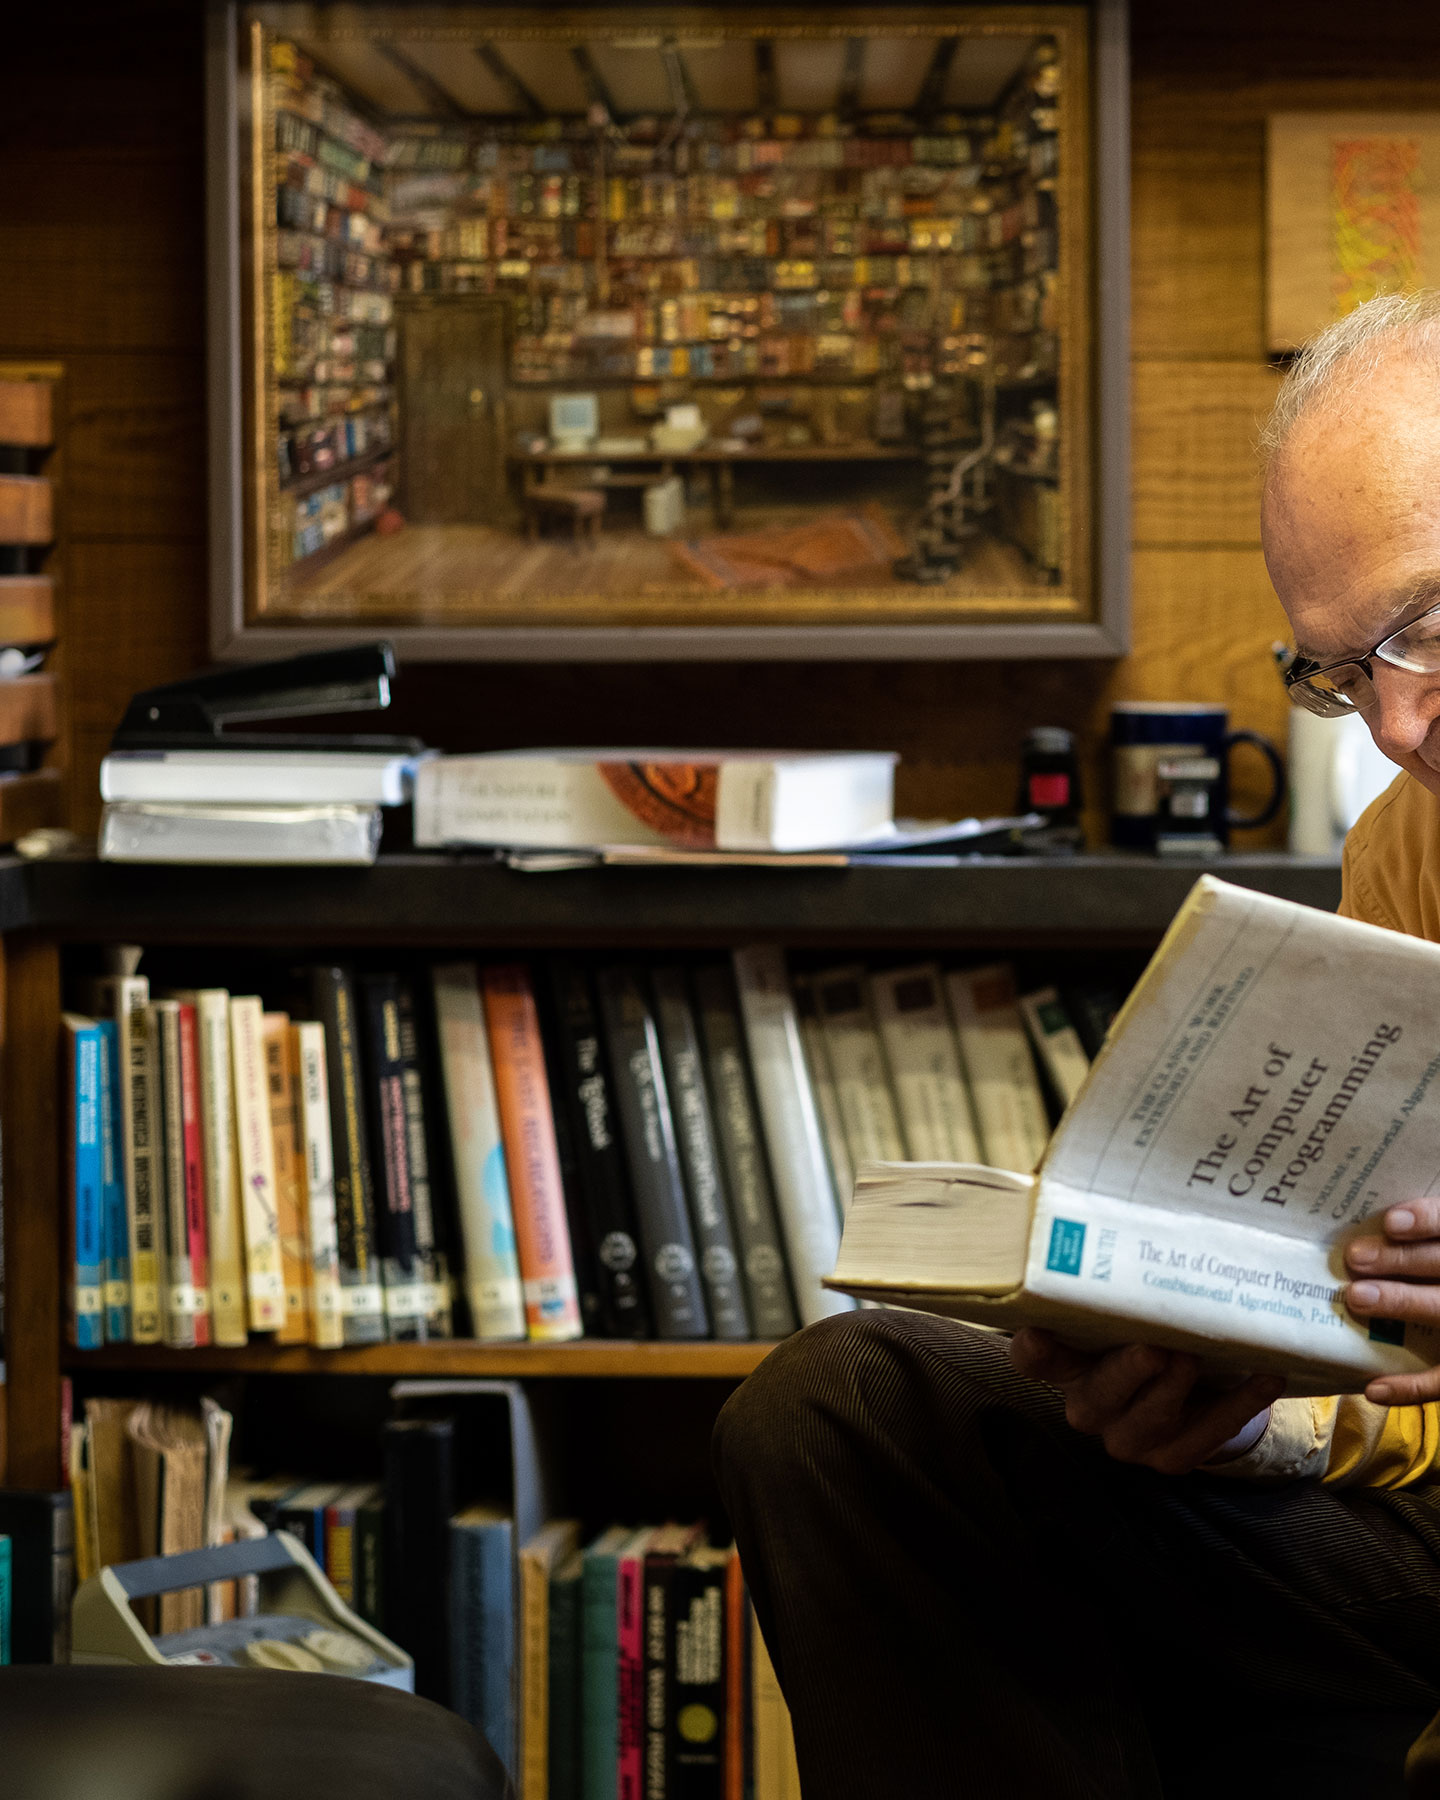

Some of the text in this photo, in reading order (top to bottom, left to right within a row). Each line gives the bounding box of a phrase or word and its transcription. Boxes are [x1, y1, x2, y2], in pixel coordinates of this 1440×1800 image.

[1187, 1041, 1294, 1187] The Art of
[1228, 1057, 1329, 1197] Computer
[1261, 1022, 1403, 1208] Programming
[1331, 1118, 1404, 1220] Combinatorial
[1091, 1228, 1119, 1282] KNUTH
[1139, 1239, 1163, 1264] The
[1167, 1247, 1187, 1269] Art
[1190, 1252, 1206, 1273] of
[1206, 1255, 1271, 1287] Computer
[1142, 1269, 1234, 1304] Combinatorial
[1311, 1306, 1336, 1326] Part
